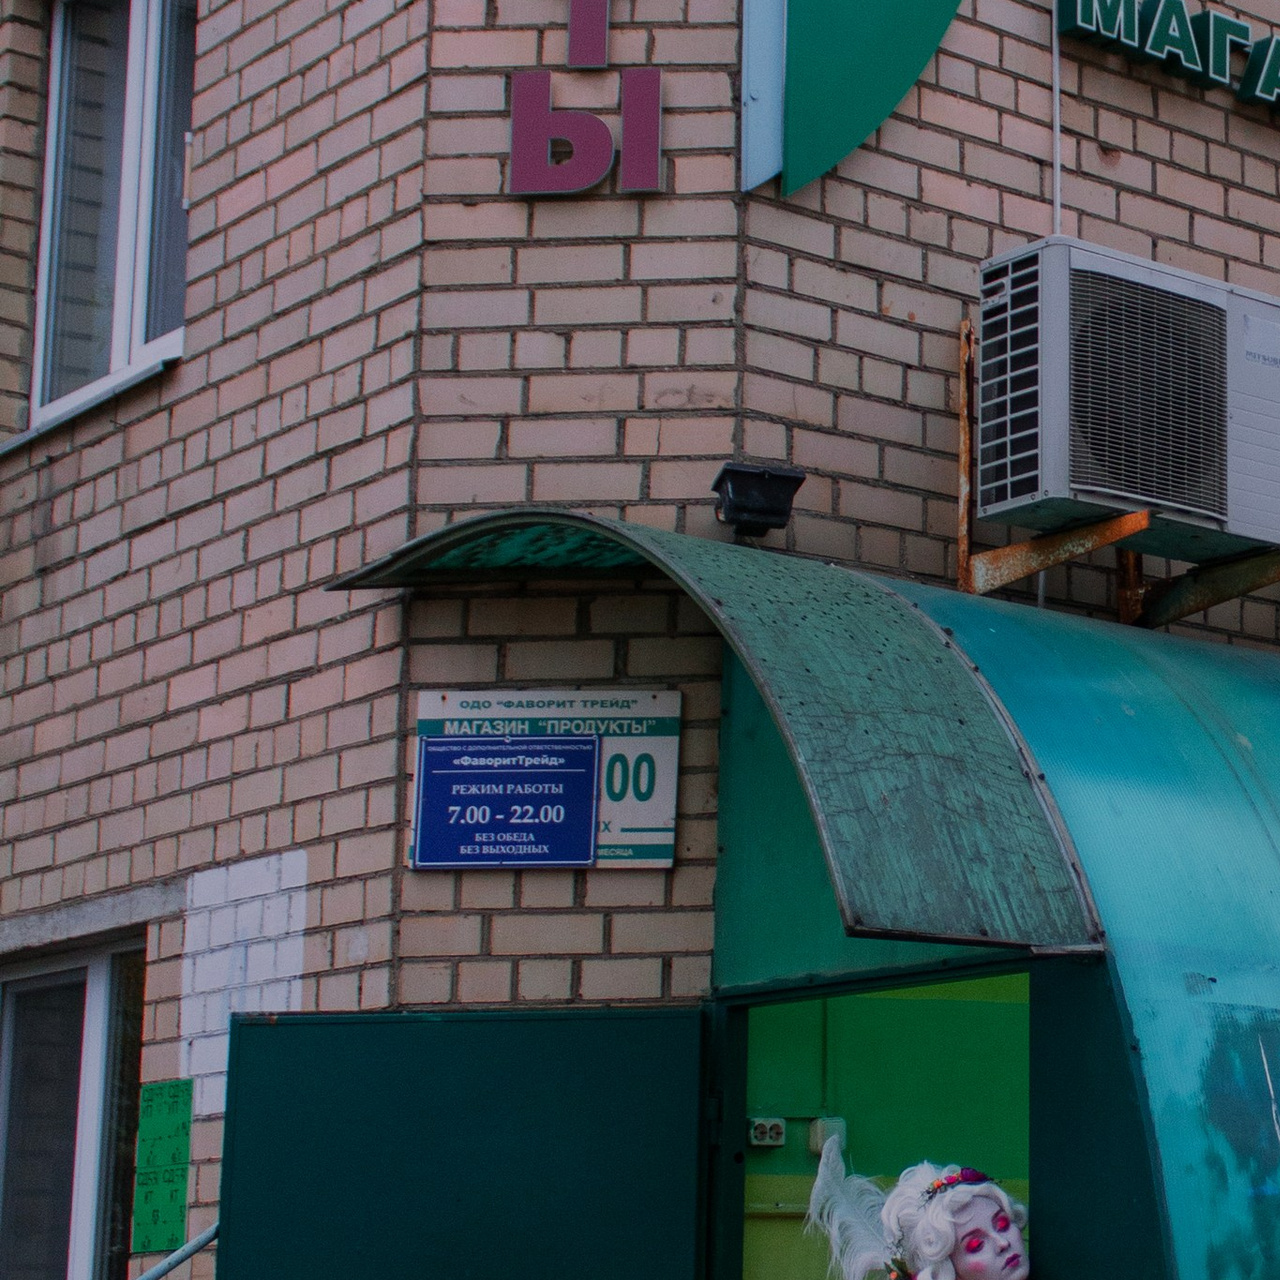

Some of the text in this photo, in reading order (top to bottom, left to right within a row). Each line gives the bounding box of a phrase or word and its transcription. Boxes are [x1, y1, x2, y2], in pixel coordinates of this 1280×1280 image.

[460, 699, 492, 710] ОДО
[443, 720, 530, 736] МАГАЗИН
[452, 783, 564, 795] РЕЖИМ РАБОТЫ
[448, 805, 491, 824] 7.00
[509, 804, 566, 824] 22.00
[475, 833, 536, 842] БЕЗ ОБЕДА
[460, 845, 550, 855] БЕЗ ВЫХОДНЫХ
